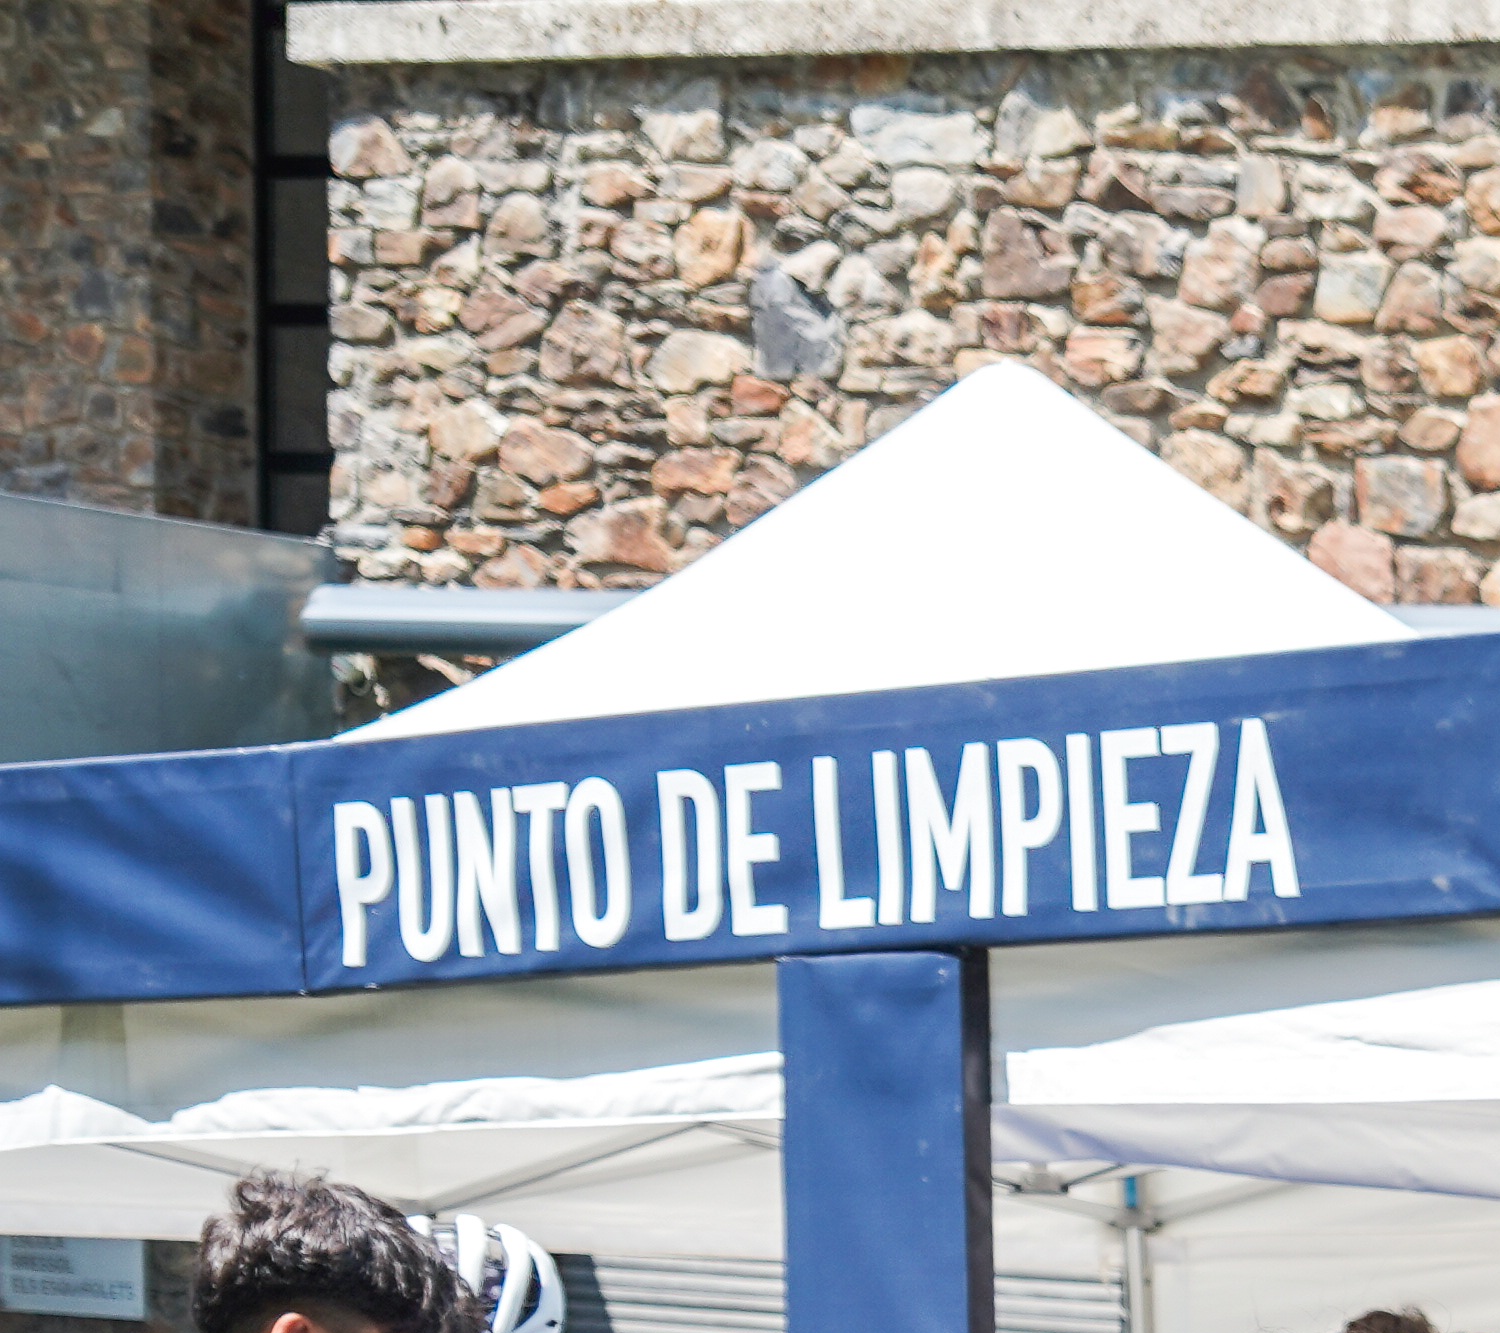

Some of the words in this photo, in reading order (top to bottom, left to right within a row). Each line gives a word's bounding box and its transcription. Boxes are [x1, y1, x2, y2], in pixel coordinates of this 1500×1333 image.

[333, 776, 631, 967] PUNTO
[658, 762, 788, 942] DE
[814, 717, 1301, 928] LIMPIEZA
